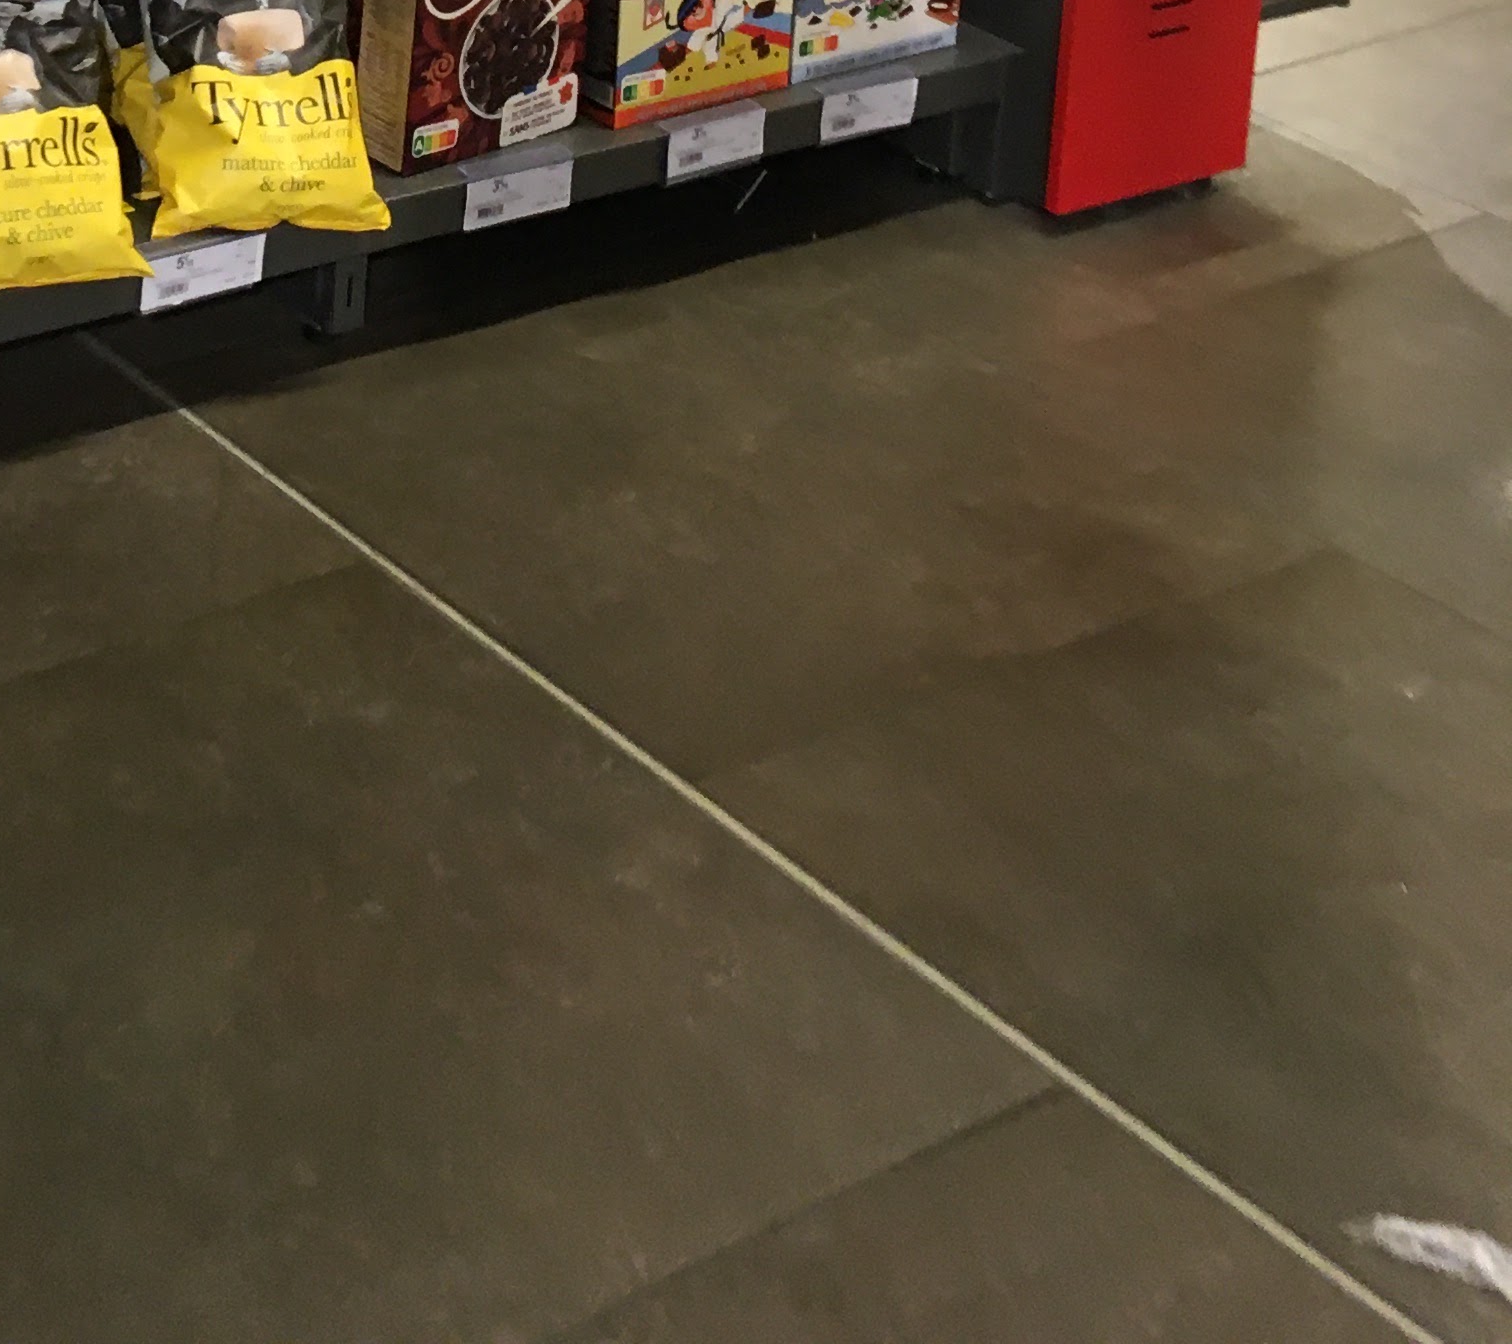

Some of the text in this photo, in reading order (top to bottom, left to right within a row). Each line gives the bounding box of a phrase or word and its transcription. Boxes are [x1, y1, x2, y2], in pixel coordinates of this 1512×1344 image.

[191, 71, 353, 145] Tyrrell'
[221, 151, 358, 172] mature cheddar
[259, 175, 326, 193] & chive
[35, 196, 104, 219] cheddar
[5, 222, 74, 245] & chive
